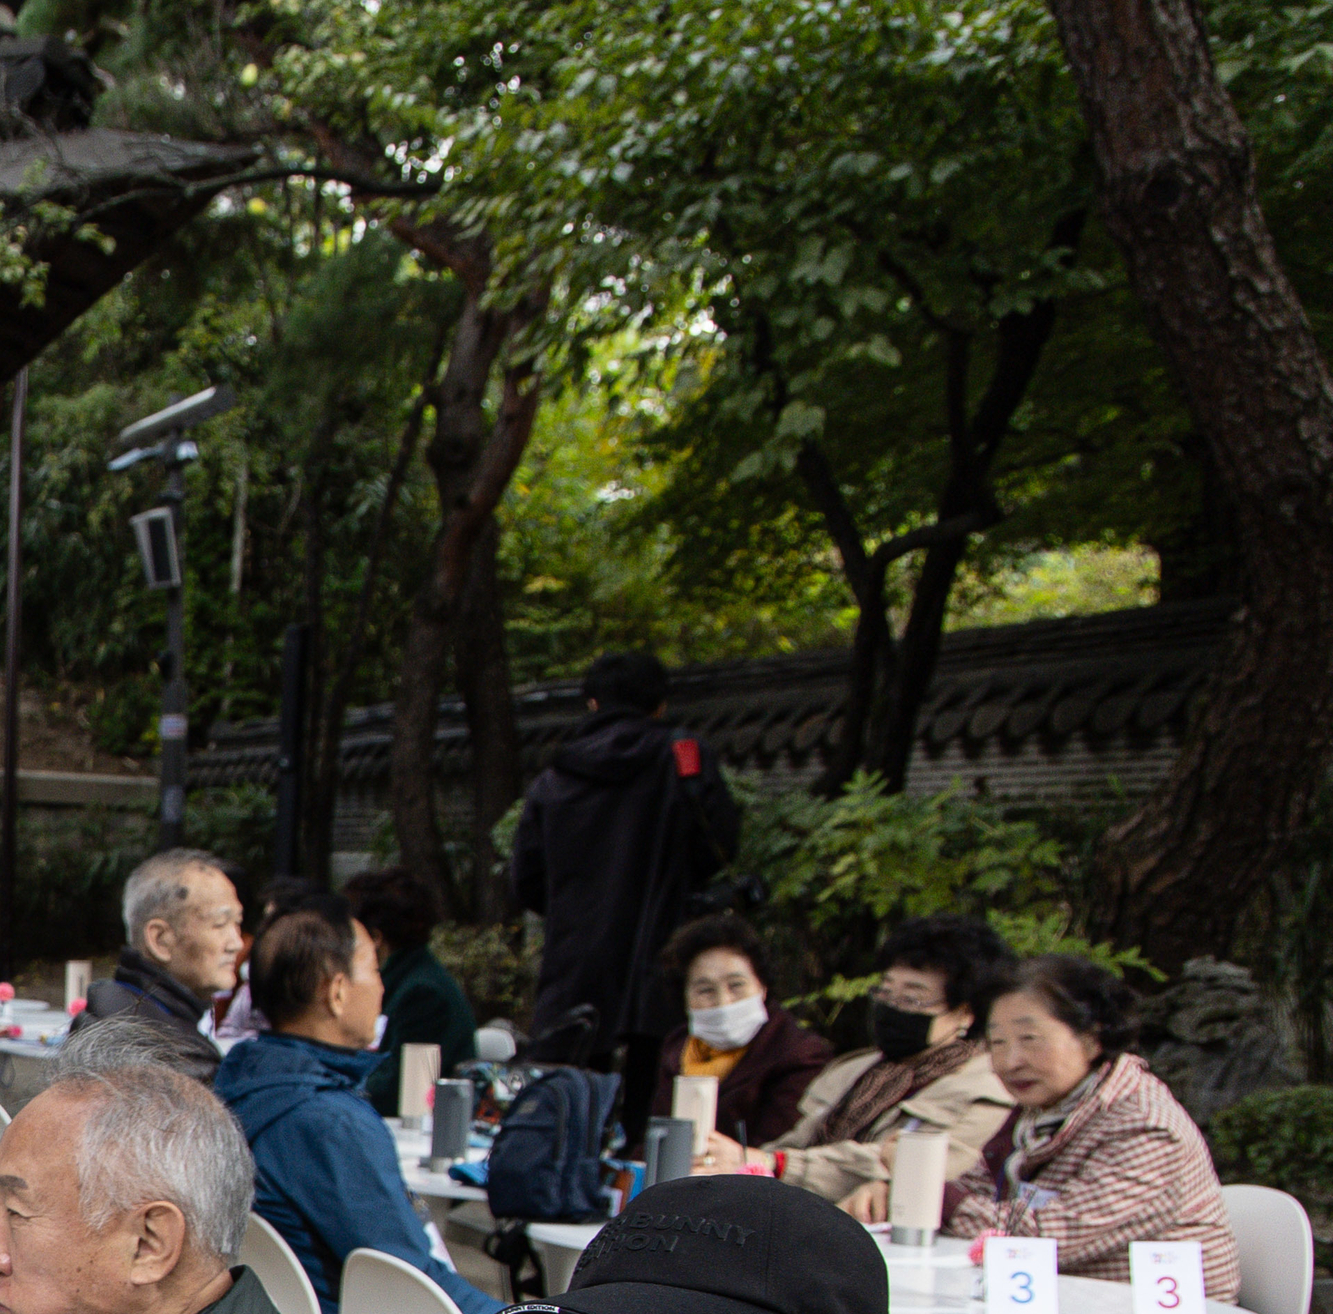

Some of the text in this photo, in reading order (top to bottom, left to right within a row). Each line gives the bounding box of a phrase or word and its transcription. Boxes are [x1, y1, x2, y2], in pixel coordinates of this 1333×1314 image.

[630, 1213, 756, 1247] BUNNY
[1011, 1271, 1035, 1304] 3
[1156, 1276, 1180, 1309] 3
